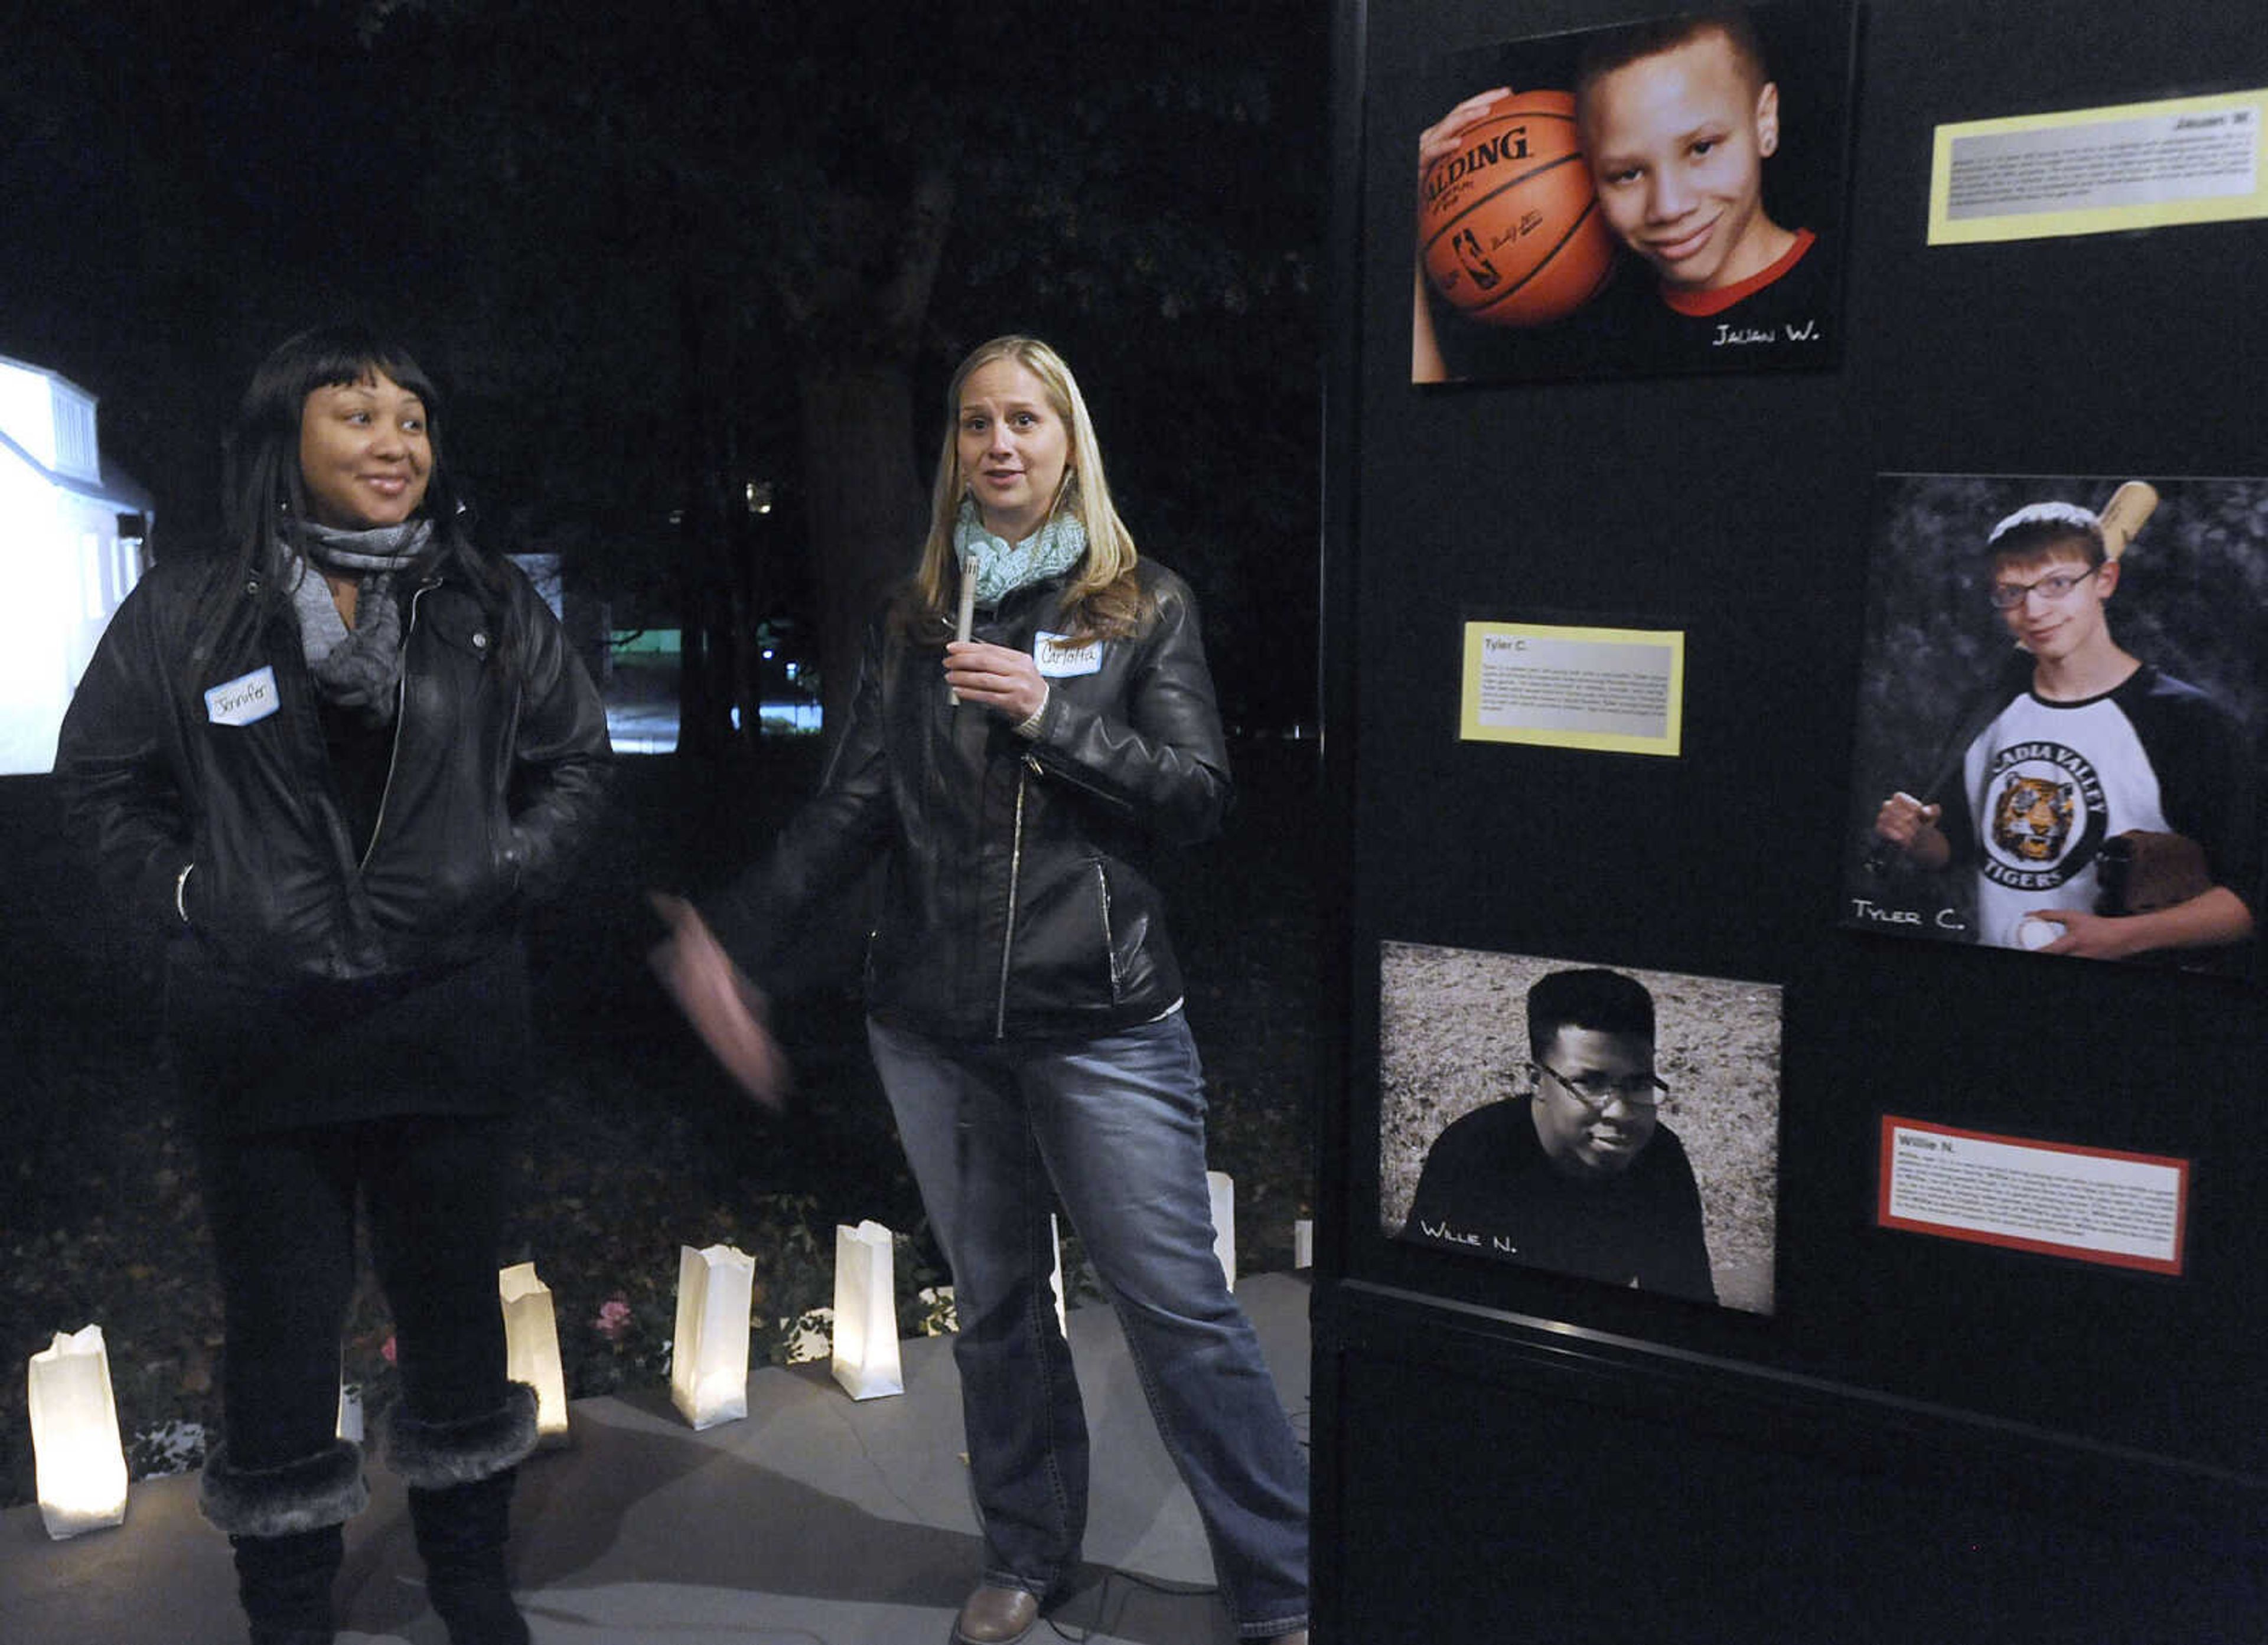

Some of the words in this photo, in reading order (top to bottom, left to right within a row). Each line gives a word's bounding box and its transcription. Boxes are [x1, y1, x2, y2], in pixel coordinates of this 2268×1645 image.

[1485, 638, 1511, 651] Tyler
[2056, 748, 2107, 813] VALLEY
[1984, 860, 2063, 887] TIGERS
